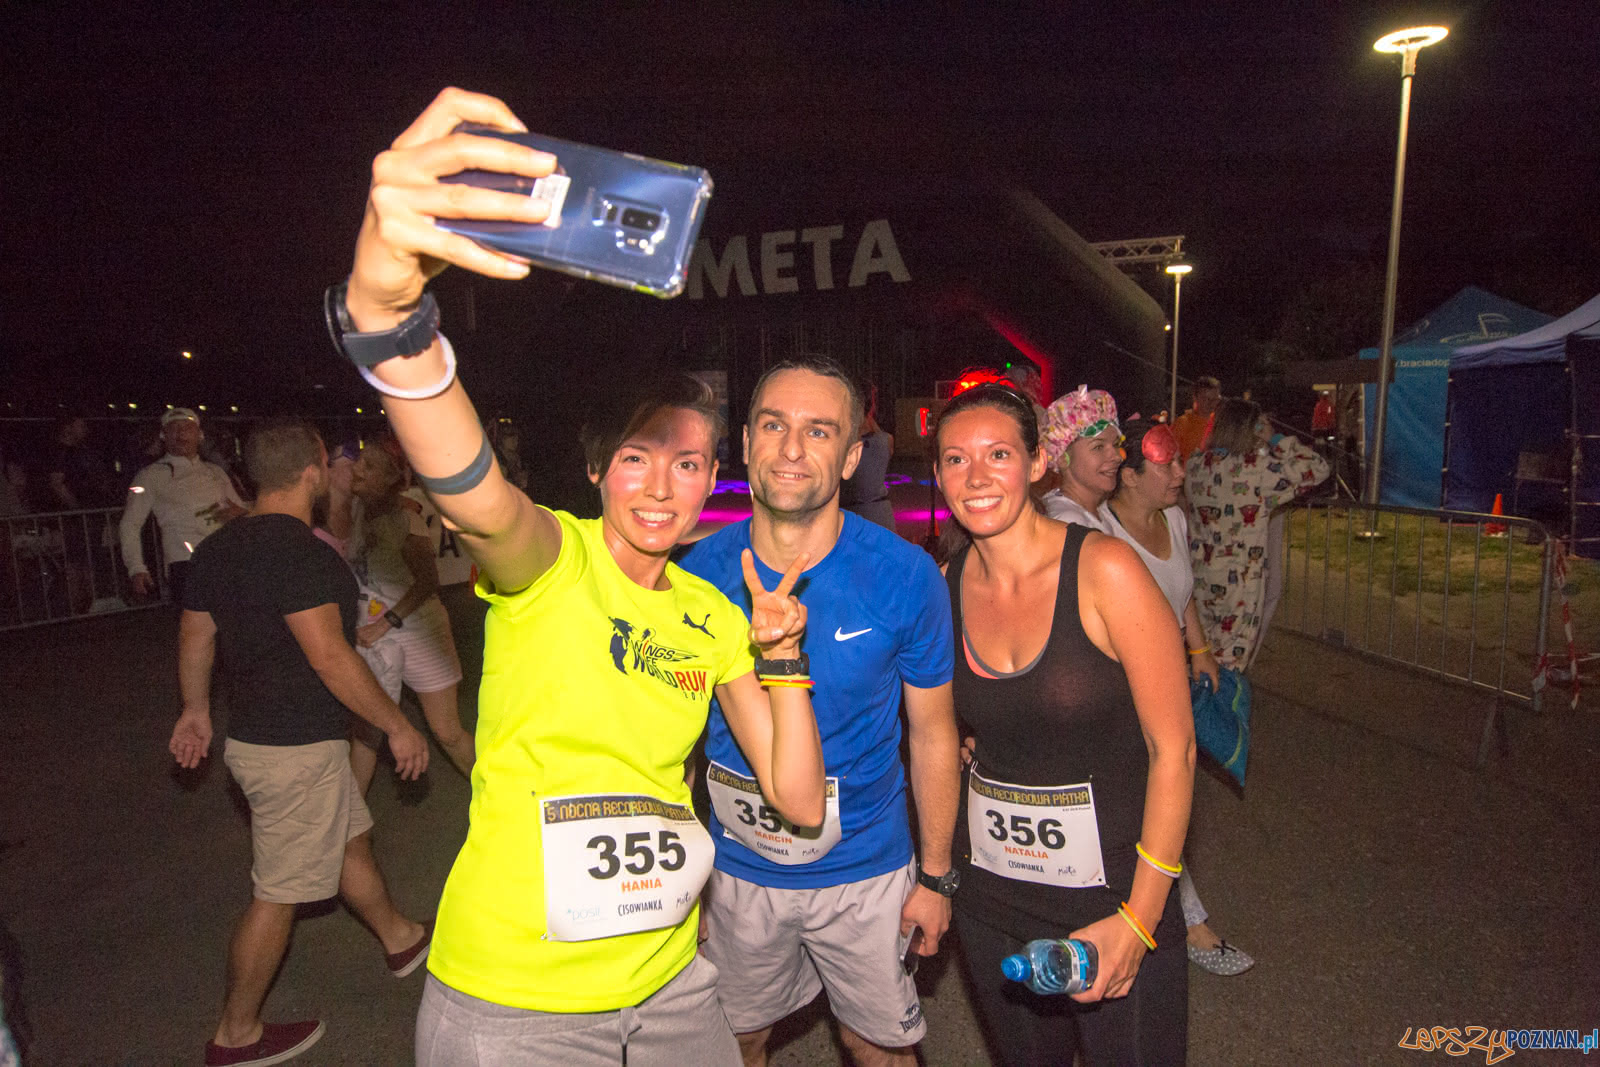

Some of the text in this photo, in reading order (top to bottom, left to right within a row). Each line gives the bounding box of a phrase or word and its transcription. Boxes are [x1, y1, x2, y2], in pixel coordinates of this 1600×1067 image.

[688, 219, 912, 299] META
[675, 671, 707, 694] RUN
[547, 806, 557, 821] 5
[754, 830, 793, 845] MARCIN
[985, 809, 1066, 850] 356
[586, 830, 687, 880] 355
[1004, 845, 1049, 860] NATALIA
[1008, 860, 1045, 874] CISOWIANKA
[621, 877, 662, 894] HANIA
[617, 899, 663, 917] CISOWIANKA
